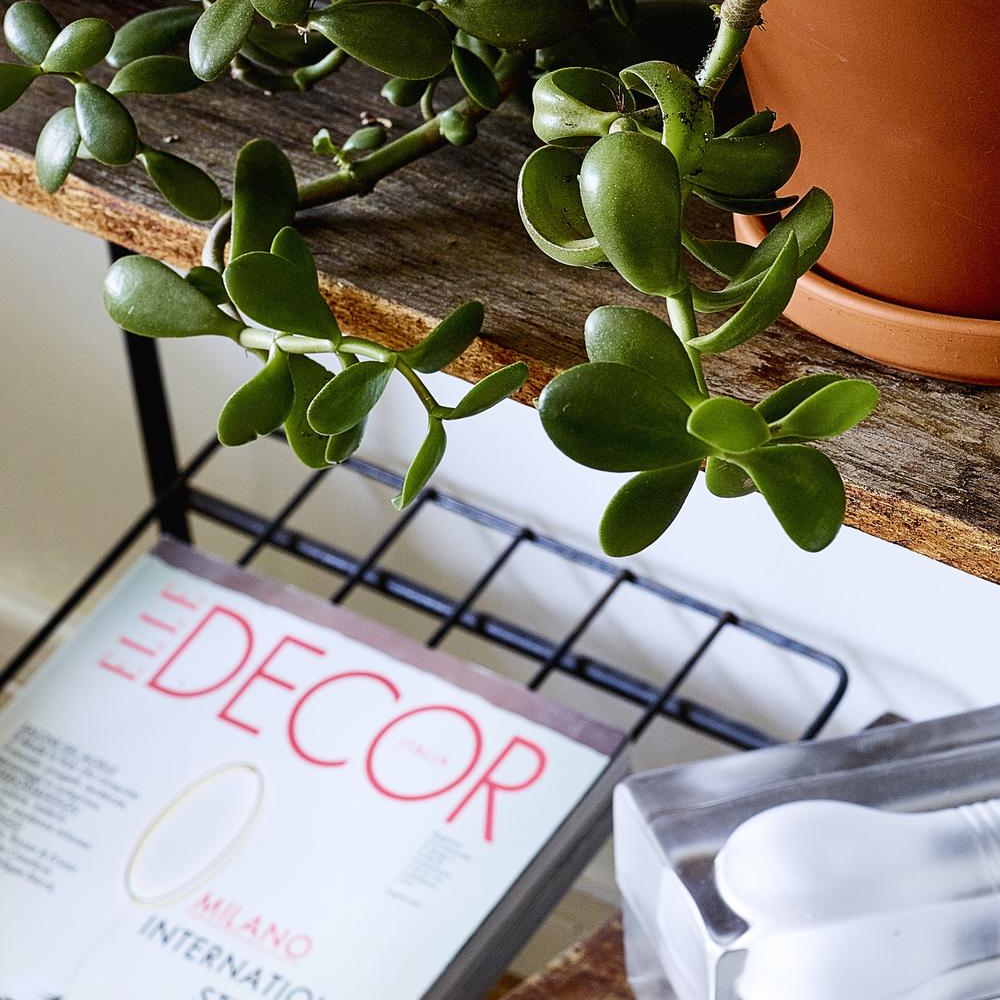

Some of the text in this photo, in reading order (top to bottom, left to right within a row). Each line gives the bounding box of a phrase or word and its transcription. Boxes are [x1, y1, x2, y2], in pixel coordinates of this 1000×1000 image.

[98, 584, 202, 681] ELLE
[147, 604, 548, 843] DECOR
[138, 914, 322, 1000] INTERNATIO
[192, 891, 315, 959] MILANO
